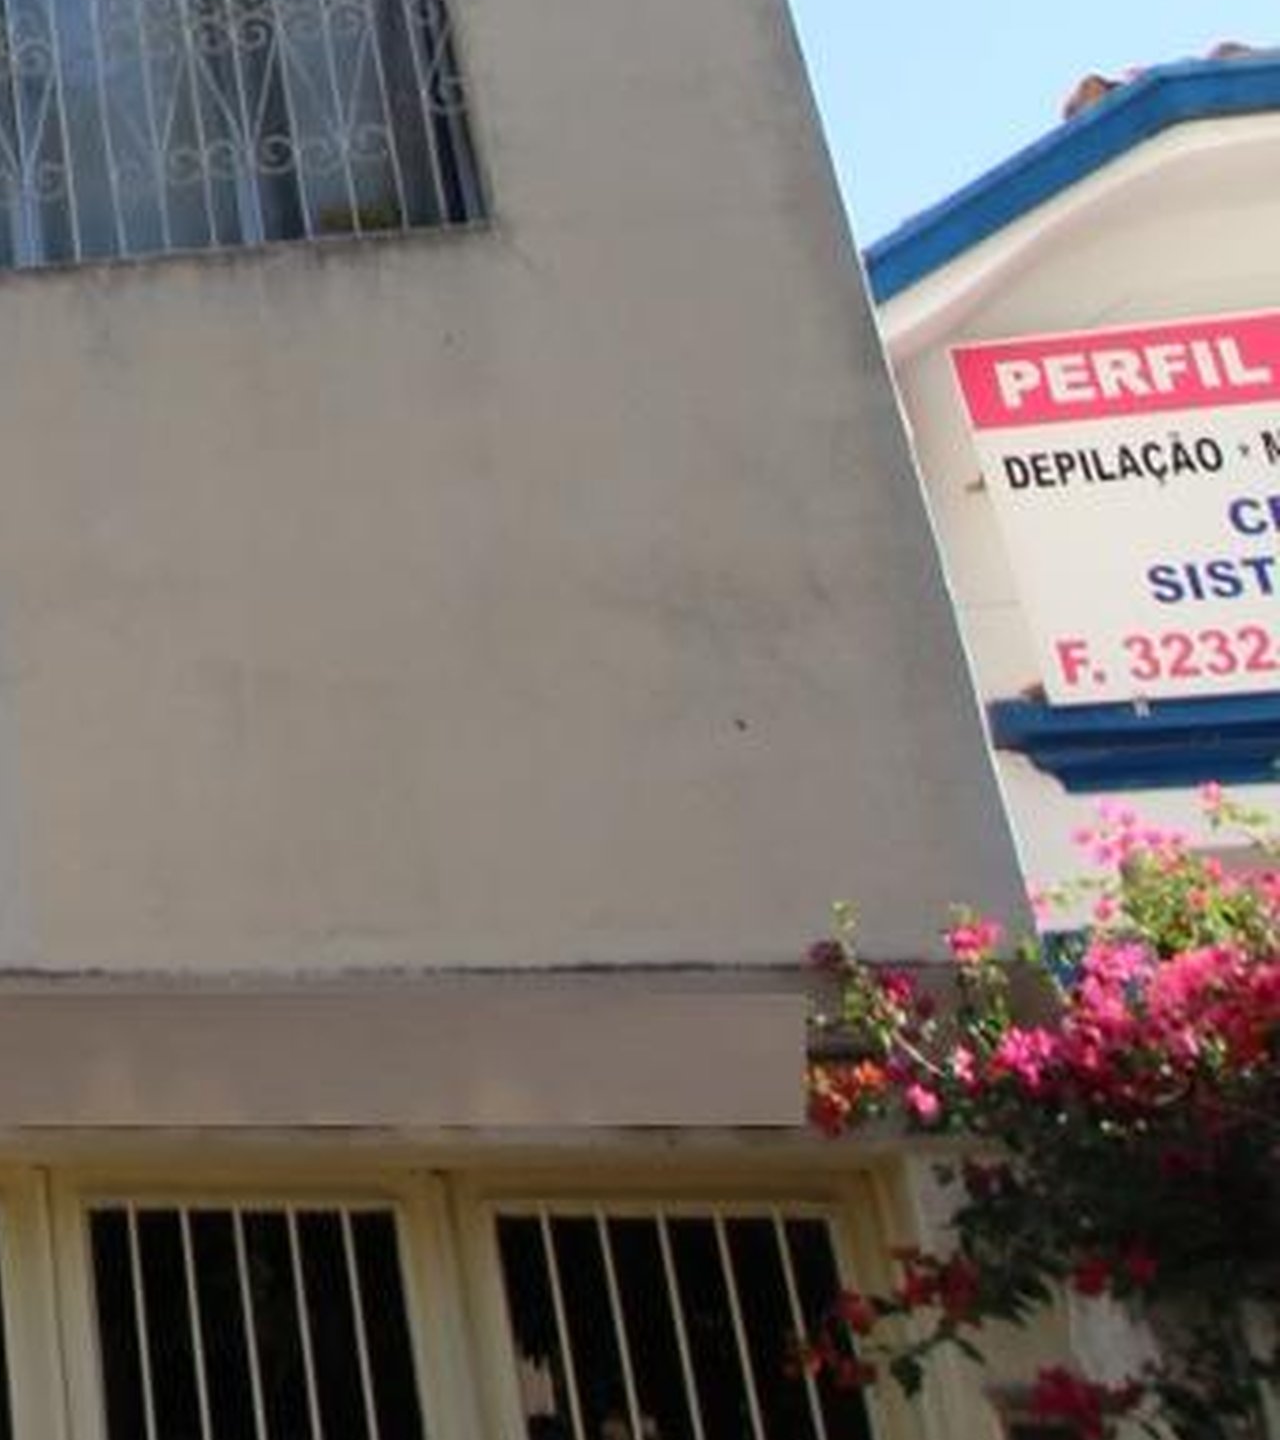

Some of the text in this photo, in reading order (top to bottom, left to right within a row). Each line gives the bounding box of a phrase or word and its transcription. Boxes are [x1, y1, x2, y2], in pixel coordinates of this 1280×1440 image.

[994, 339, 1271, 409] PERFIL
[1003, 431, 1223, 489] DEPILAÇÃO
[1147, 556, 1276, 604] SIST
[1056, 625, 1280, 686] F. 3232
